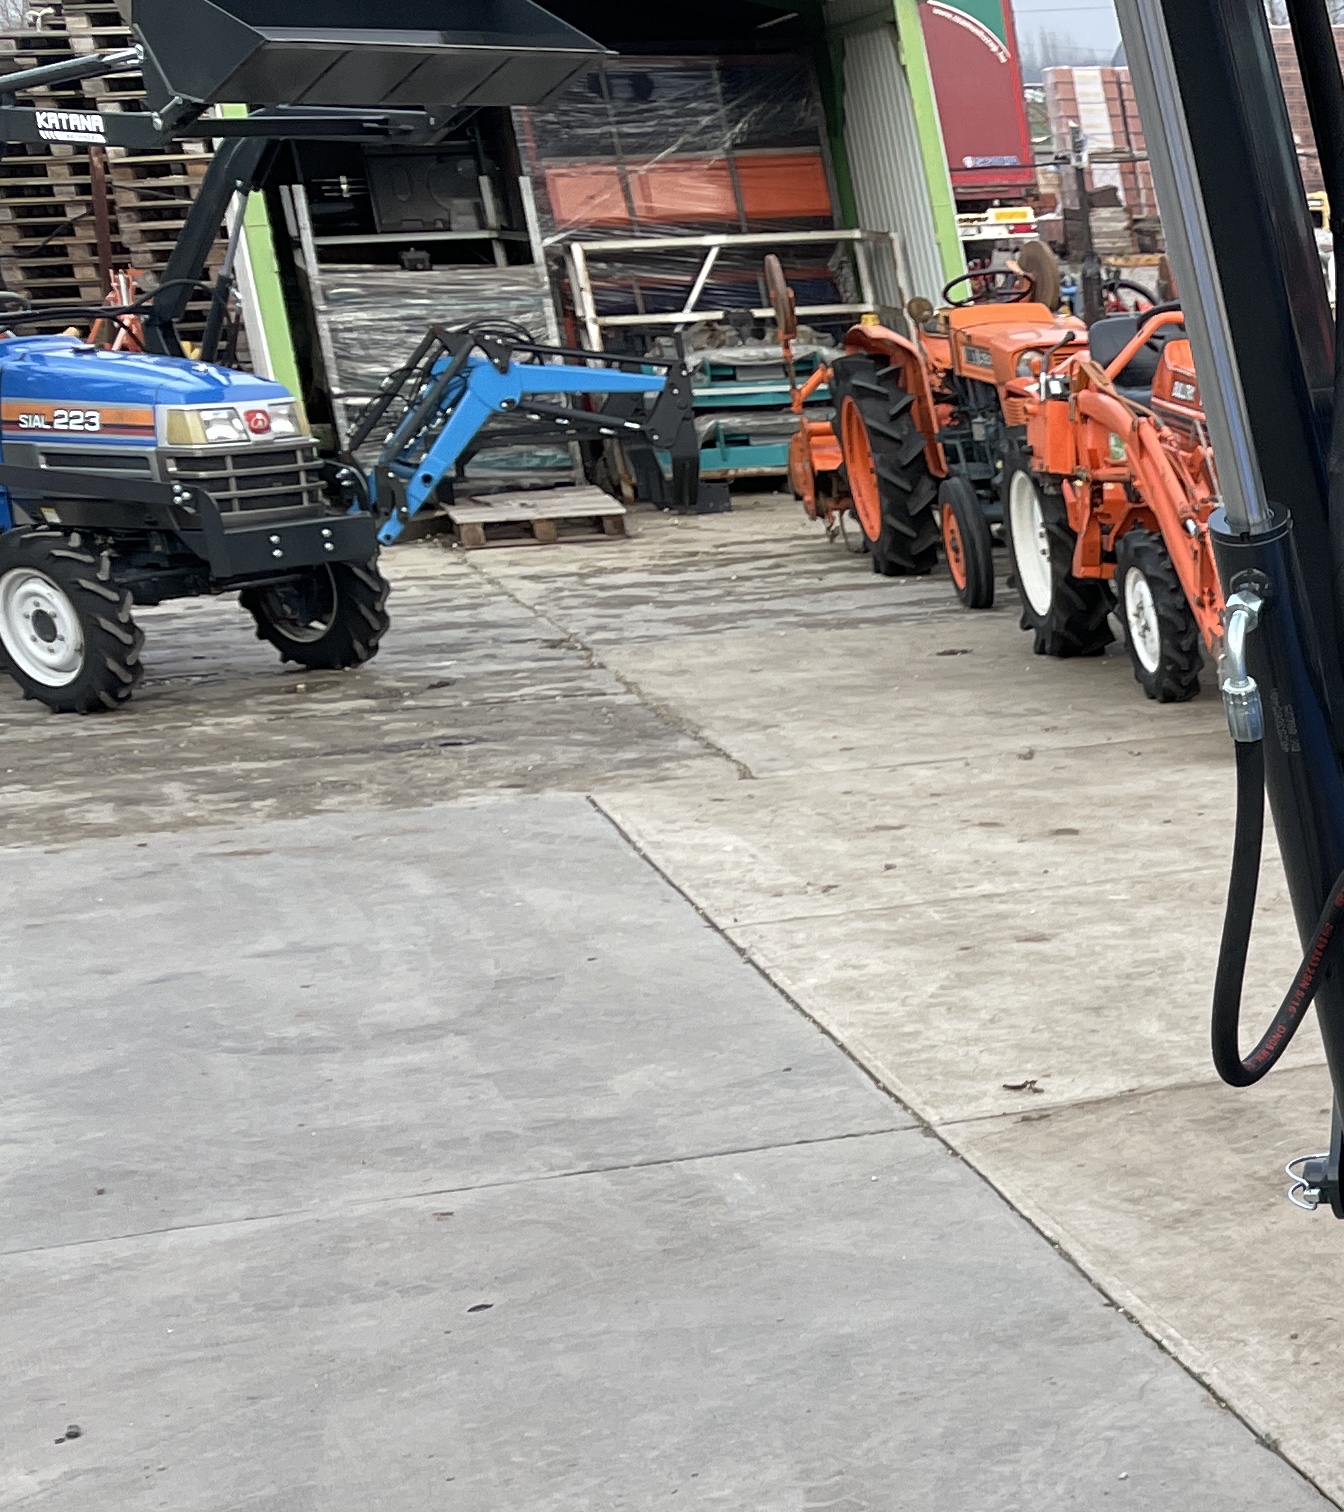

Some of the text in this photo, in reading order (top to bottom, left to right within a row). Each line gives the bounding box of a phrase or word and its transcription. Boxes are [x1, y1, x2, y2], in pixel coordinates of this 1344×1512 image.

[36, 111, 104, 133] KATANA
[19, 409, 101, 431] SIAL 223
